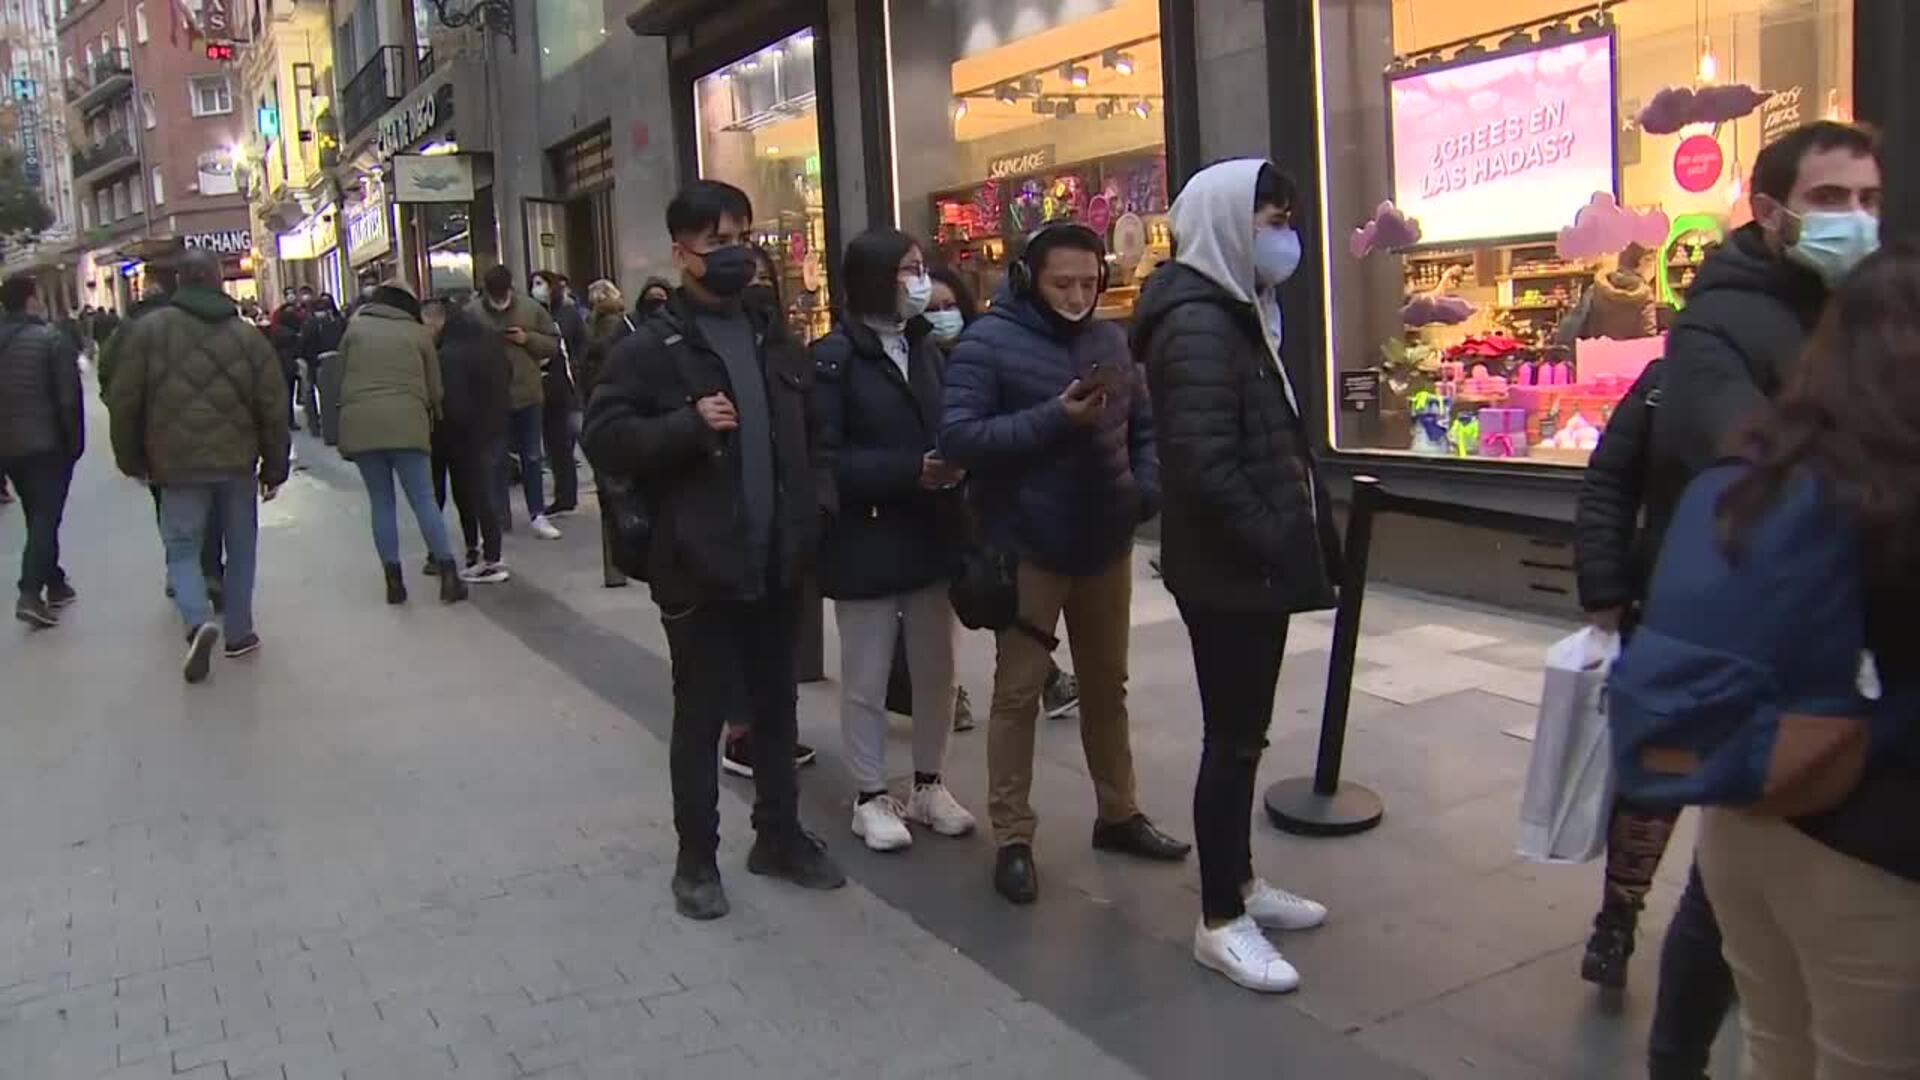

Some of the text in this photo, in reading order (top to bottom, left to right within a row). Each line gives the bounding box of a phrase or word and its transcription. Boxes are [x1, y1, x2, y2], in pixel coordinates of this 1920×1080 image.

[1529, 98, 1566, 134] EN
[1421, 130, 1575, 199] LAS HADAS?
